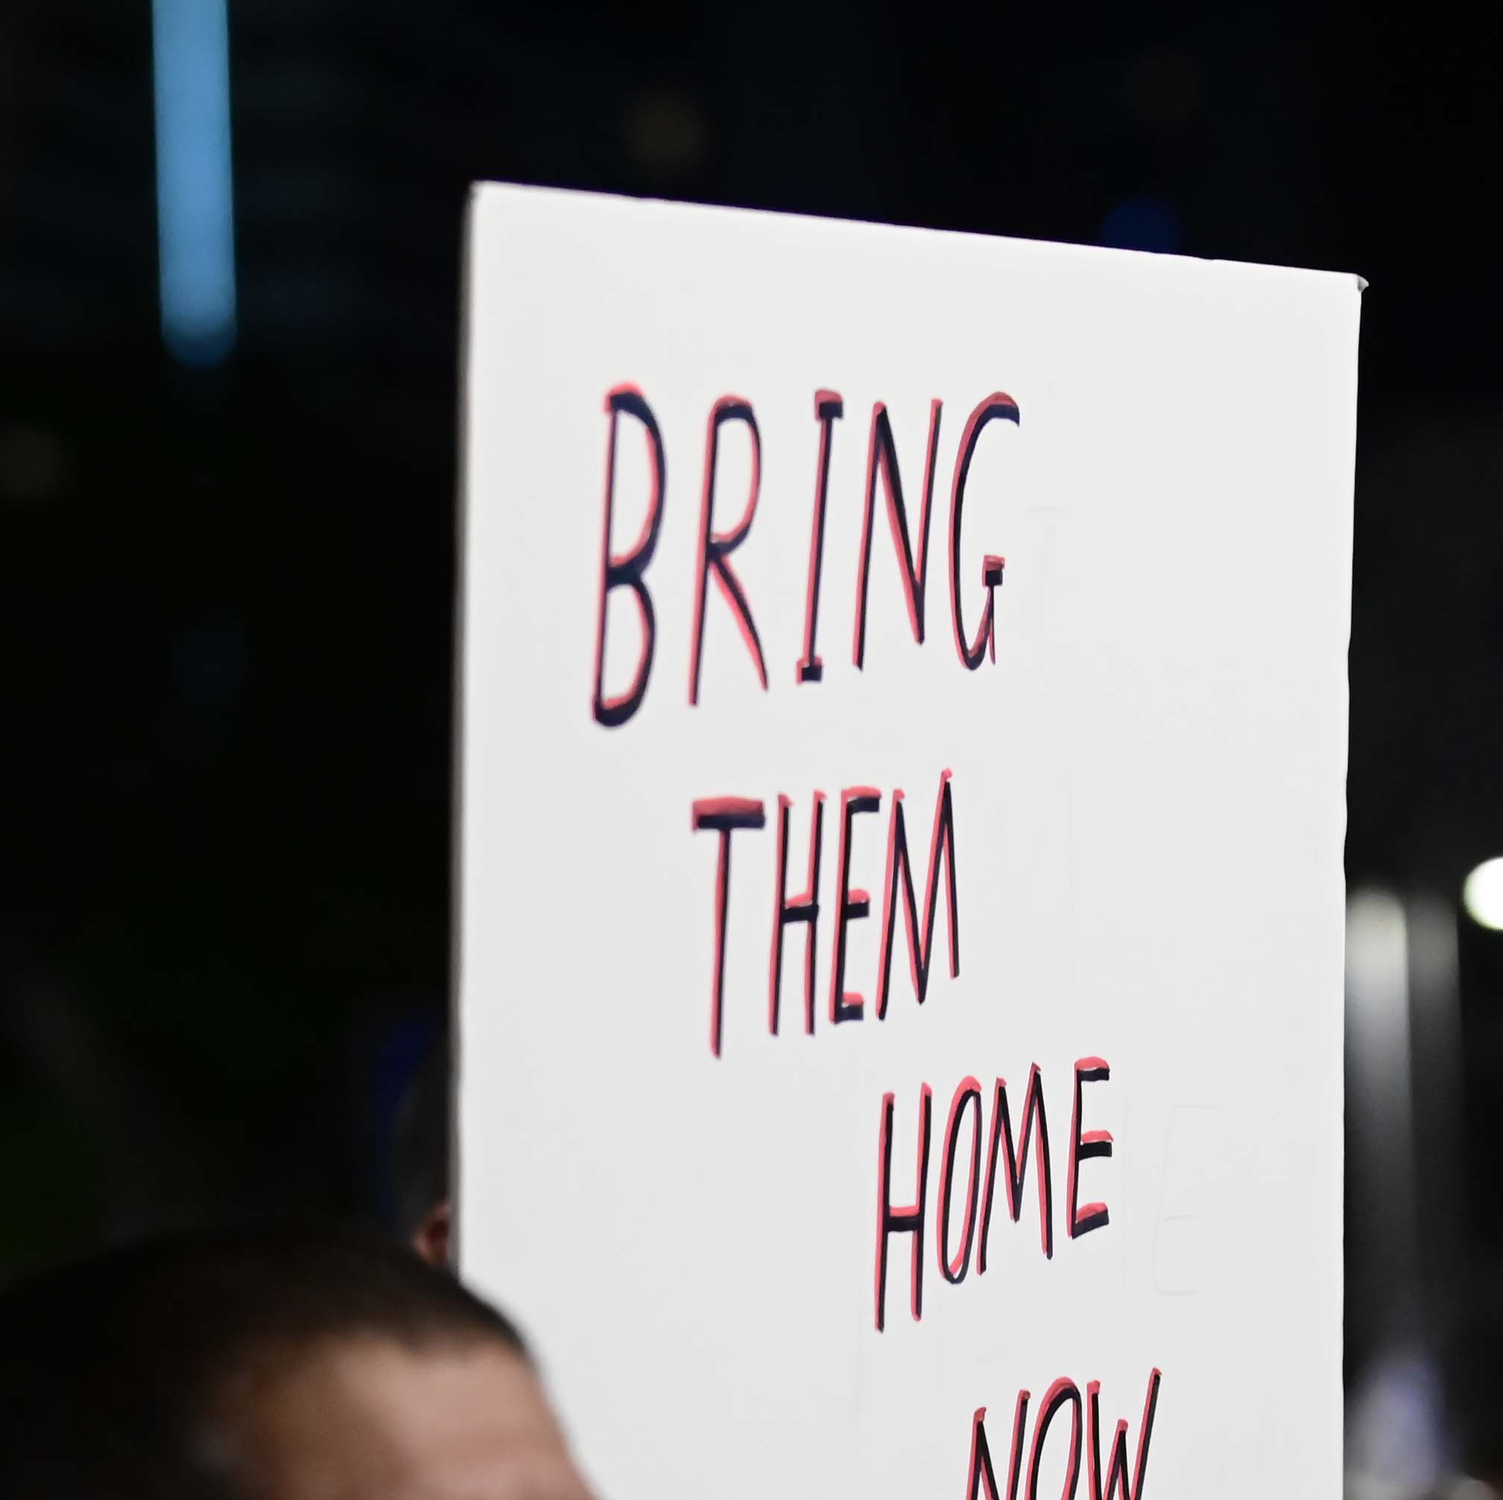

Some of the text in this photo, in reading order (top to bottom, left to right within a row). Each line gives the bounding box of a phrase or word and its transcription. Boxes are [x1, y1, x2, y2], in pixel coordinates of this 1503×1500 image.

[592, 384, 1021, 728] BRING
[692, 769, 960, 1058] THEM
[875, 1057, 1113, 1333] HOME
